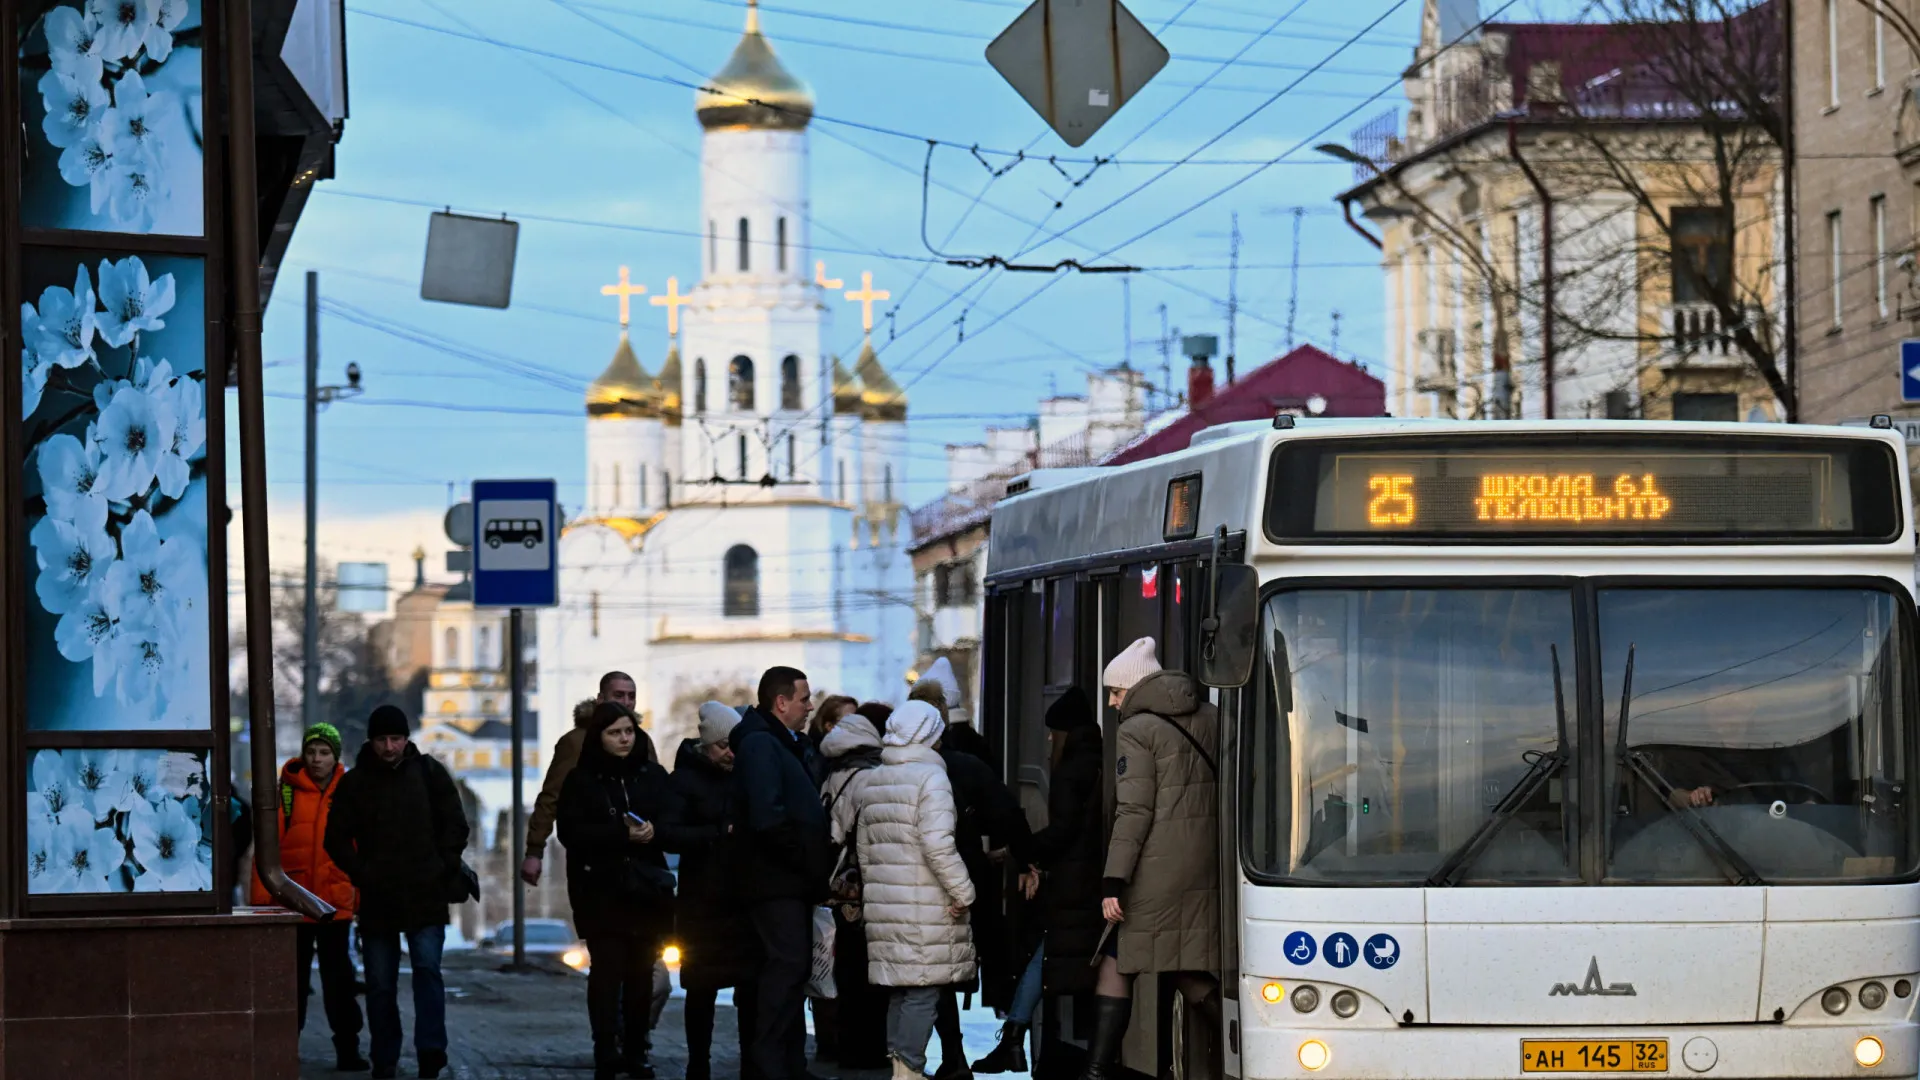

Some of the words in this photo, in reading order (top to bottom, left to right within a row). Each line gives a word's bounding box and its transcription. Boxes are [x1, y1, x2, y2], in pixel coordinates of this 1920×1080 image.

[1481, 474, 1594, 496] ШКОЛА
[1615, 474, 1659, 496] 61
[1369, 476, 1414, 523] 25
[1475, 497, 1670, 522] ТЕЛЕЦЕНТР
[1578, 1045, 1621, 1067] 145
[1635, 1043, 1658, 1060] 32
